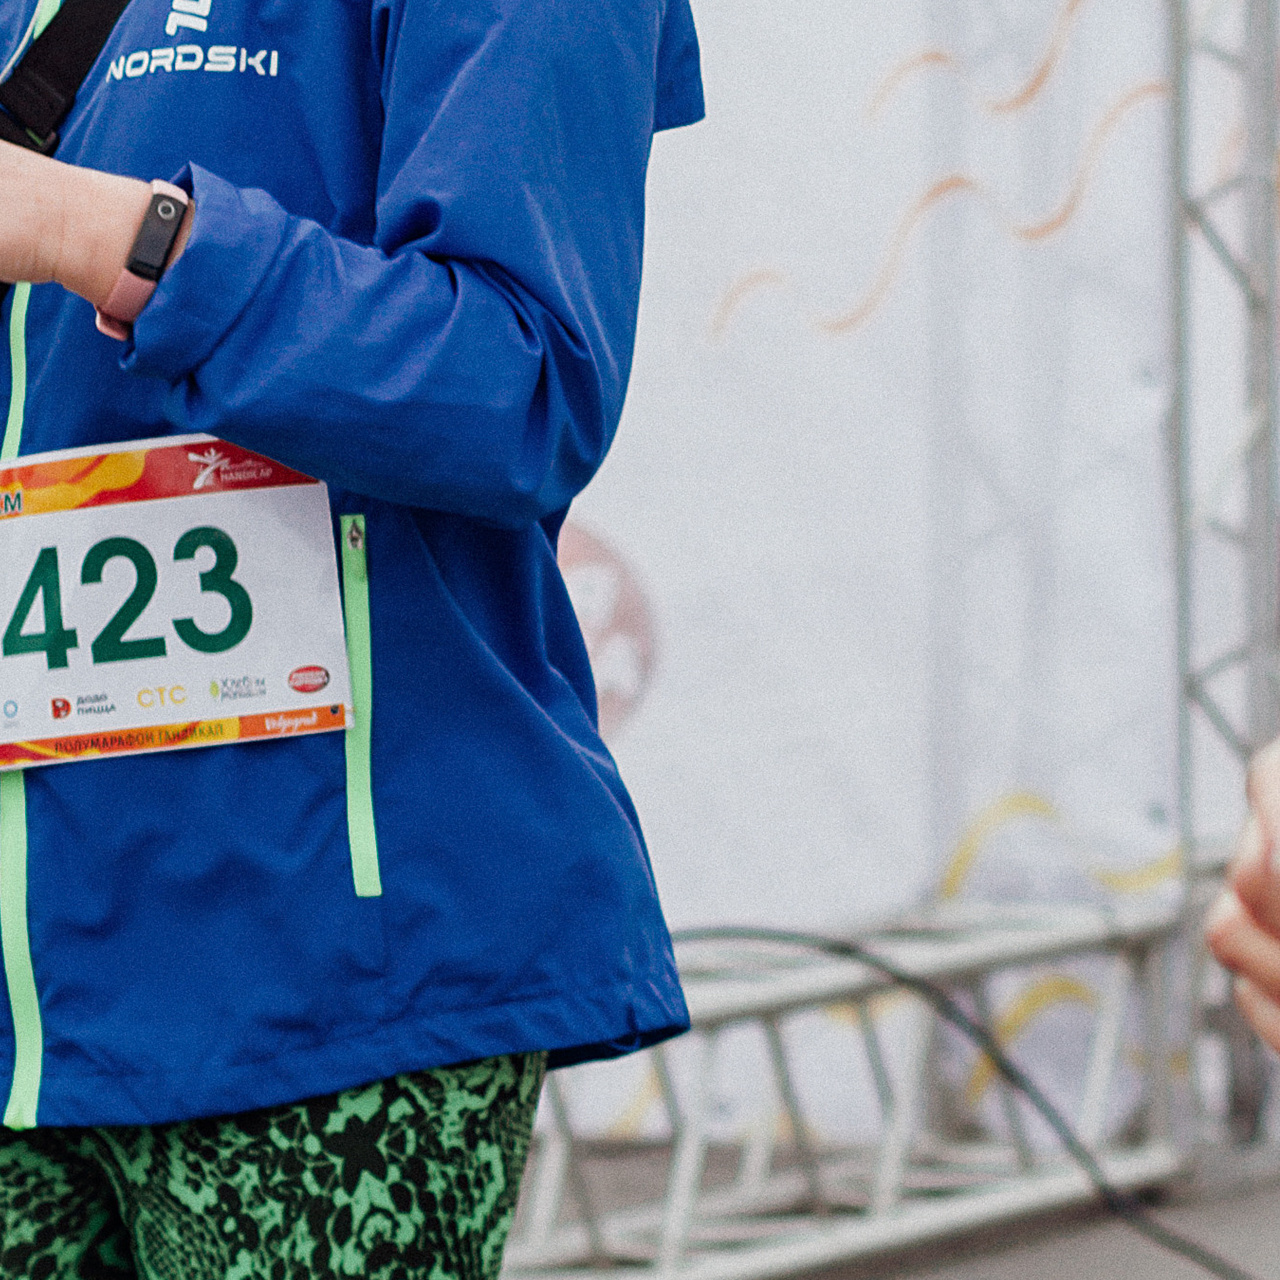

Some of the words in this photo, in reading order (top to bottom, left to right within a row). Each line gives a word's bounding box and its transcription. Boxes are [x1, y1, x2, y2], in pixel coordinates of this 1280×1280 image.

[105, 43, 279, 84] NORDSKI
[1, 525, 254, 670] 423
[54, 730, 154, 754] ПОЛУМАРАФОН
